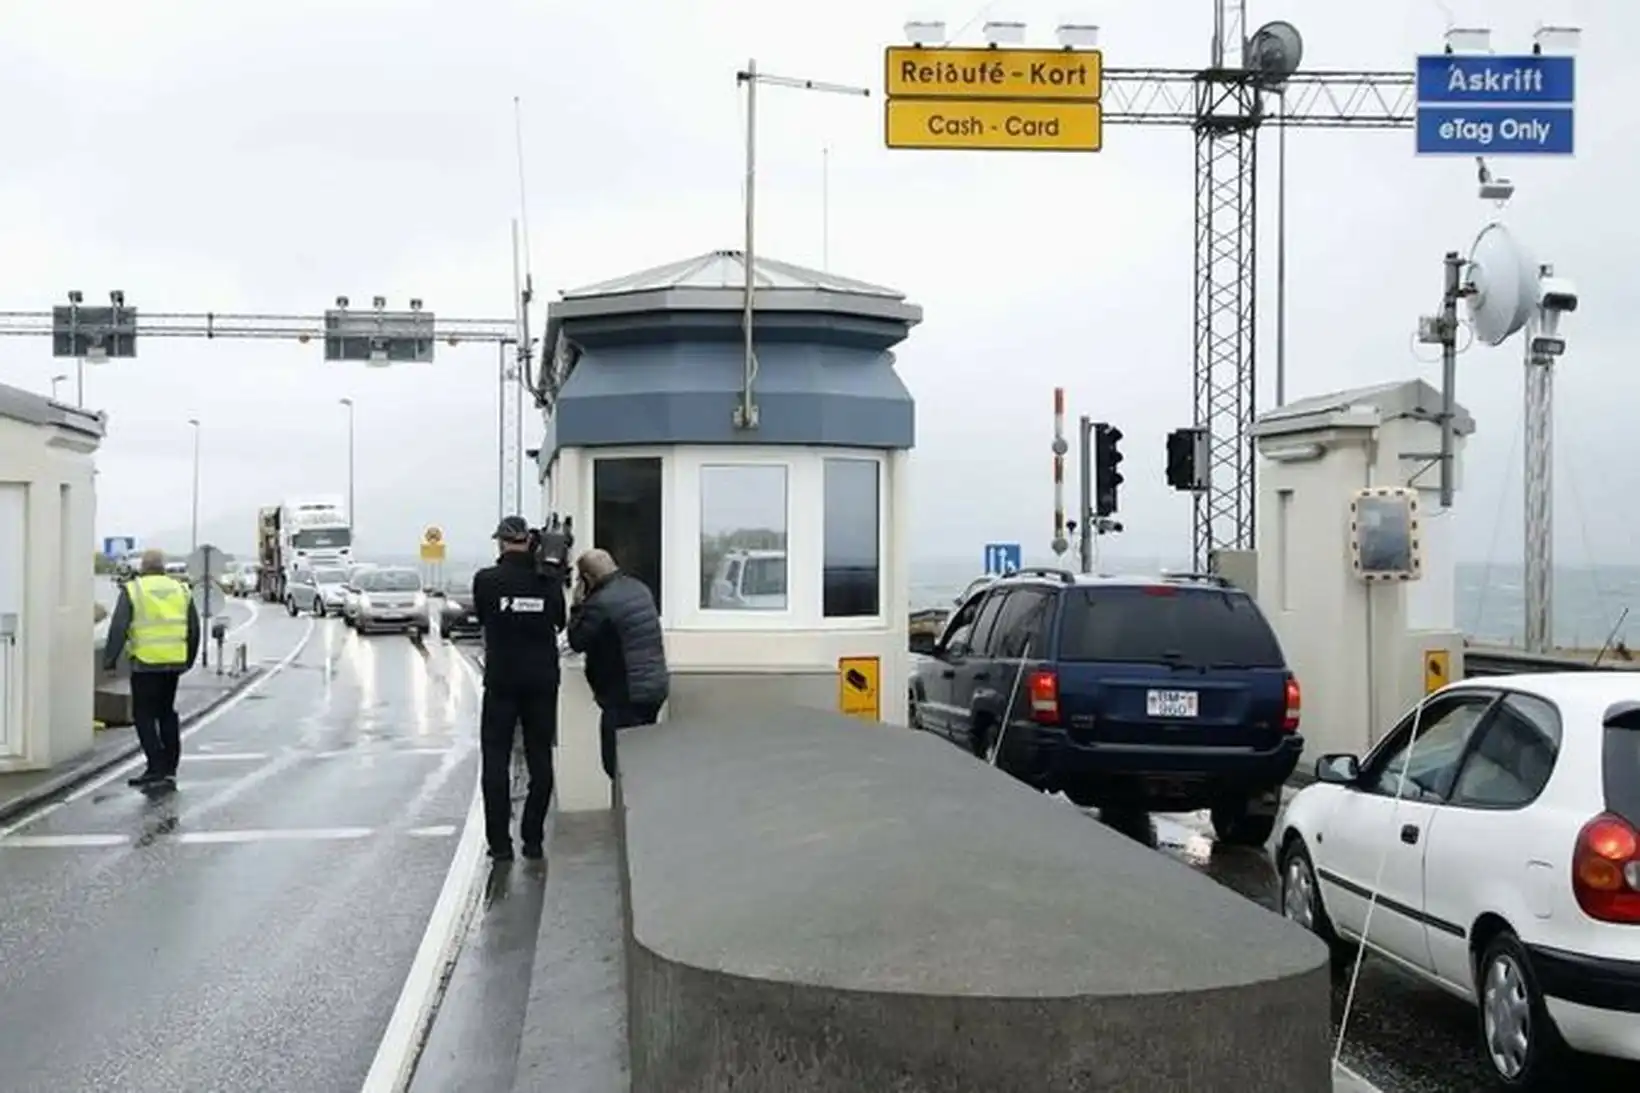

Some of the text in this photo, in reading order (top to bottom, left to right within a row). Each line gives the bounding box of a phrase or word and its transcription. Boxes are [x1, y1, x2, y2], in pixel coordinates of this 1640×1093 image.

[901, 61, 1005, 84] Reiðufé
[1030, 62, 1087, 85] Kort
[1448, 64, 1543, 92] Áskrift
[927, 114, 983, 135] Cash
[1005, 115, 1060, 136] Card
[1439, 117, 1550, 145] eTag Only
